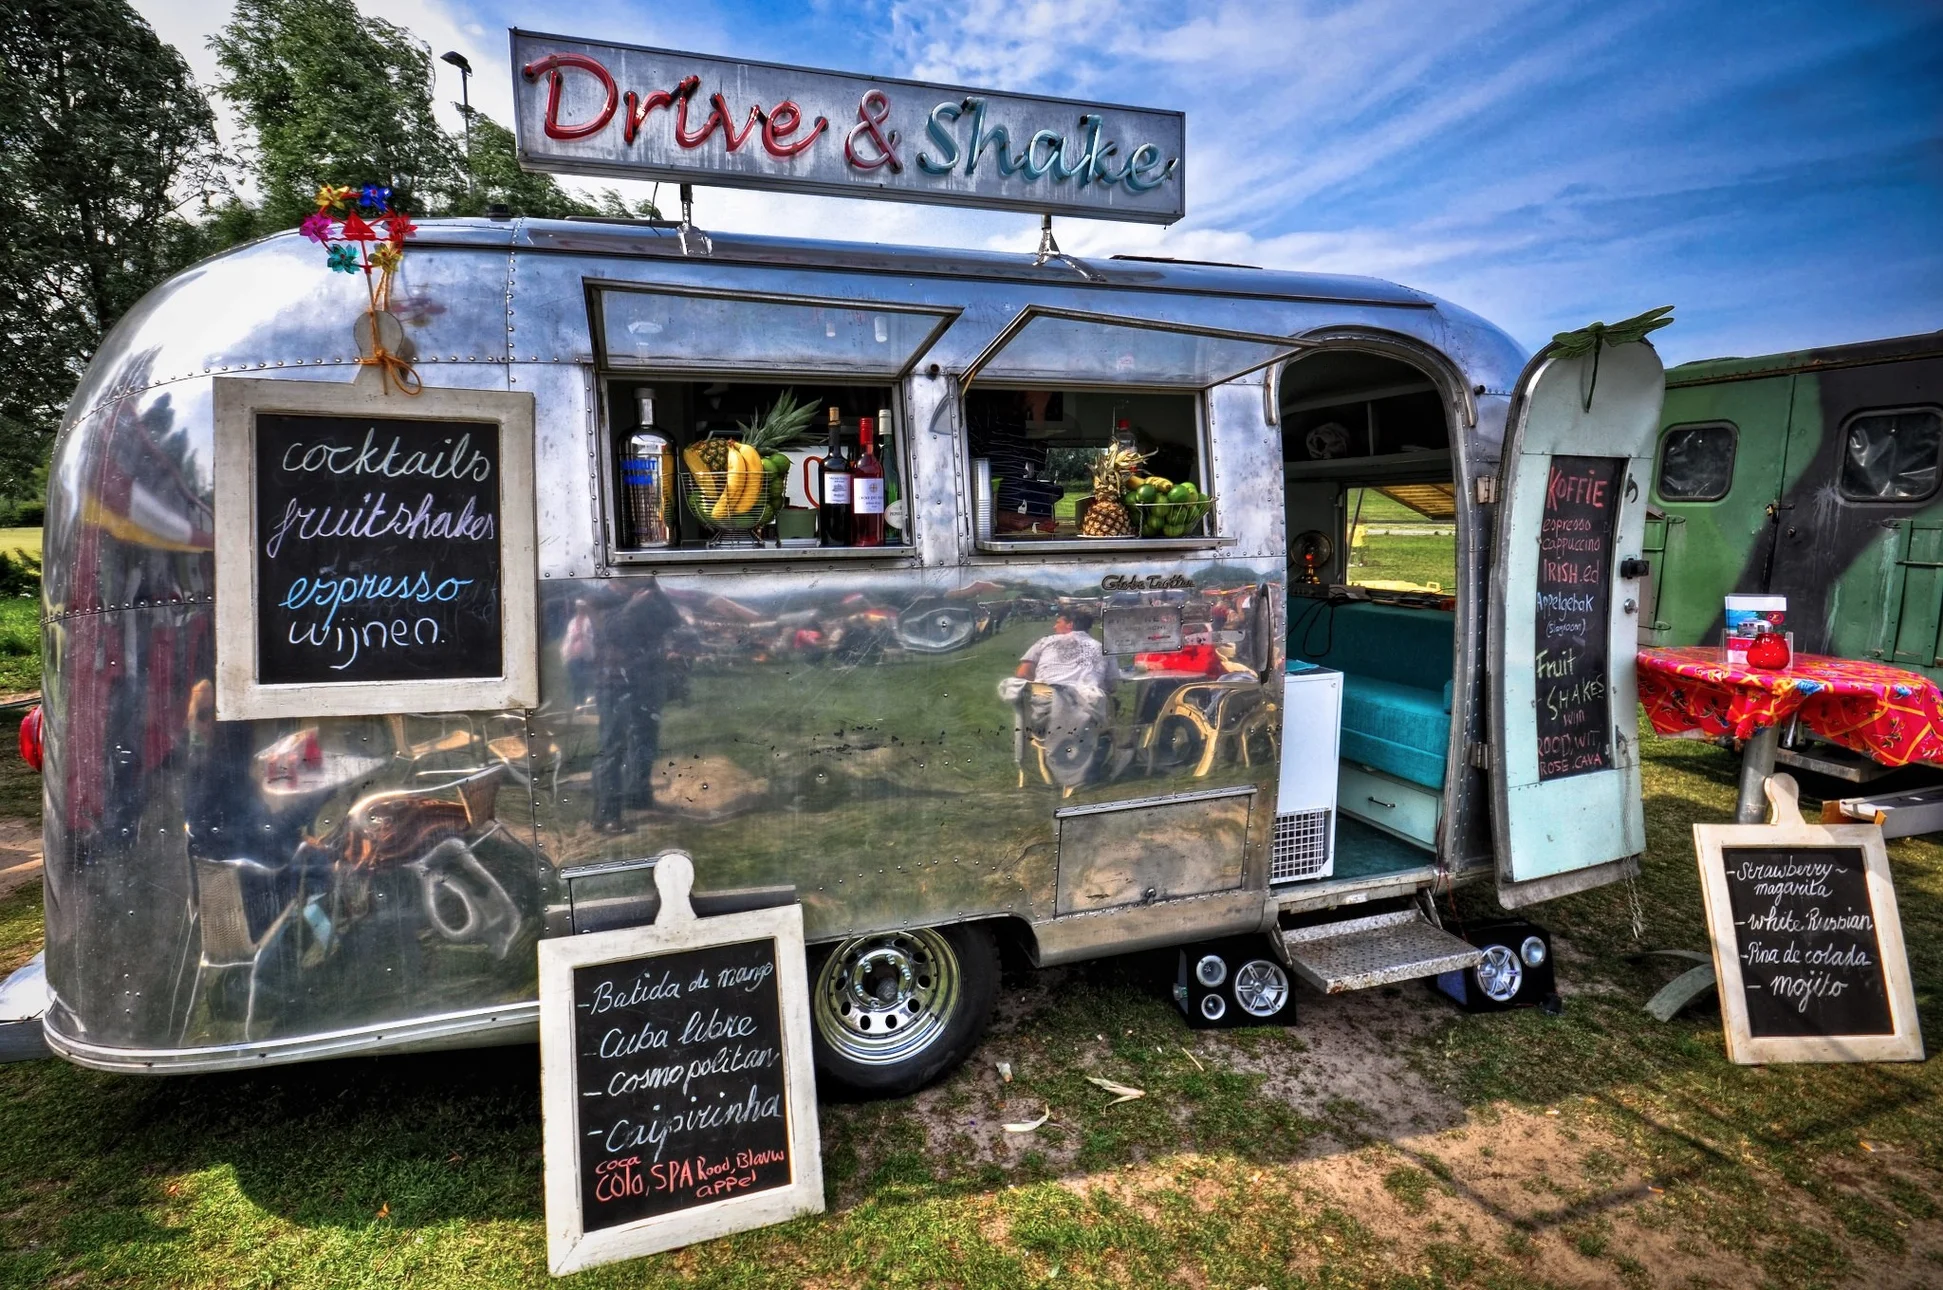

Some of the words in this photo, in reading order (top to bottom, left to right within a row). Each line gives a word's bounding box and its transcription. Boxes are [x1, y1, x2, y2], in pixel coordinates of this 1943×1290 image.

[523, 53, 828, 158] Drive
[844, 88, 902, 173] &
[917, 95, 1180, 191] Shake
[282, 428, 491, 482] cocktails
[1546, 466, 1608, 512] KOFFIE
[266, 493, 494, 558] fruitshakes
[1542, 519, 1592, 538] espresso
[1542, 538, 1601, 556] cappuccino
[279, 571, 474, 631] espresso
[1536, 648, 1576, 679] Fruit
[1547, 674, 1605, 720] SHAKES
[1806, 906, 1873, 933] Russian
[1783, 941, 1800, 964] de
[1805, 943, 1872, 967] colada
[688, 970, 710, 990] de
[678, 1008, 758, 1044] libre
[650, 1158, 694, 1194] SPA
[736, 1149, 785, 1170] Blauw
[695, 1169, 757, 1198] appel
